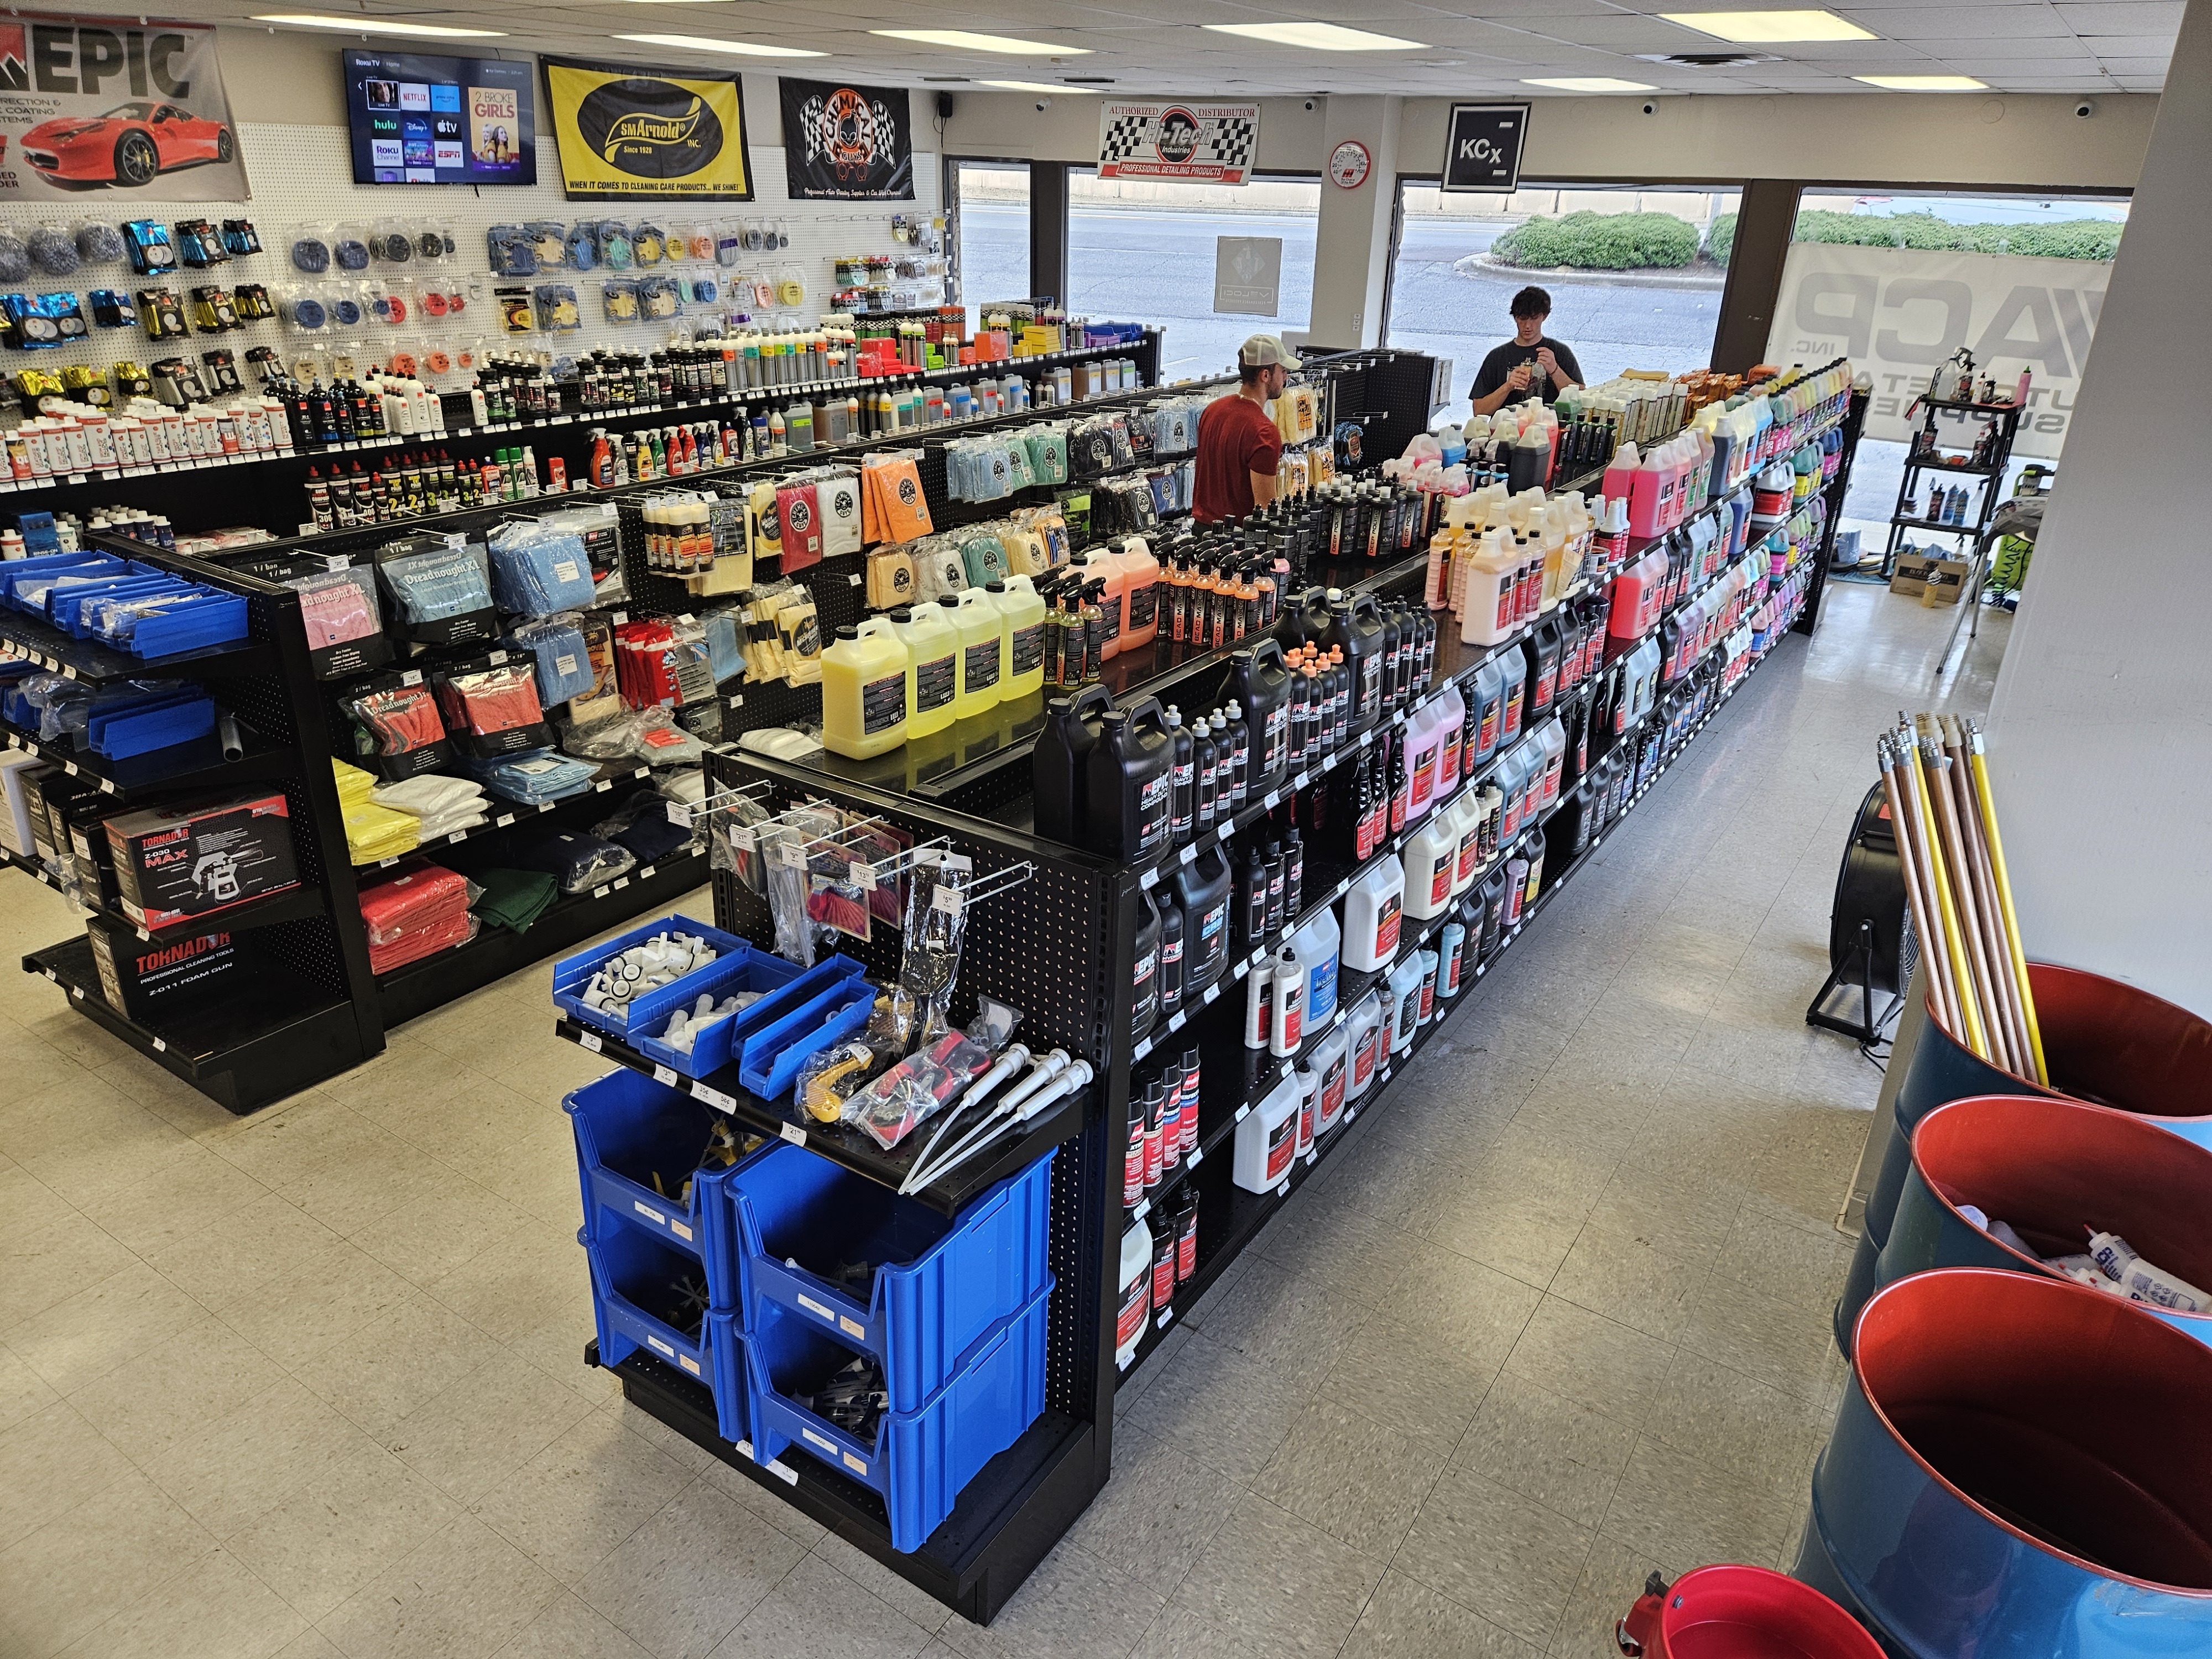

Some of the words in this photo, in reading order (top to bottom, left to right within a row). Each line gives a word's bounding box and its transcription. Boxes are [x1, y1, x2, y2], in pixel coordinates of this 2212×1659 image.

[32, 25, 190, 98] EPIC
[403, 93, 426, 102] NETFLIX
[476, 91, 482, 101] 2
[484, 92, 513, 103] BROKE
[475, 103, 515, 118] GIRLS
[1109, 106, 1159, 116] AUTHORIZED
[1199, 108, 1255, 117] DISTRIBUTOR
[374, 119, 397, 129] hulu
[826, 95, 871, 141] CHEMICAL
[377, 145, 399, 154] Roku
[624, 145, 638, 154] Since
[687, 139, 701, 148] INC.
[1162, 145, 1191, 154] Industries
[842, 152, 862, 162] GUYS
[1121, 164, 1160, 173] PROFESSIONAL
[1162, 166, 1190, 174] DETAILING
[1191, 167, 1221, 176] PRODUCTS
[570, 181, 587, 189] WHEN
[597, 181, 618, 190] COMES
[319, 514, 332, 523] 300
[404, 563, 468, 585] Dreadnought
[371, 694, 420, 714] Dreadnought
[1275, 703, 1288, 724] EPIC
[1152, 771, 1169, 795] EPIC
[1140, 792, 1168, 811] COMPOUND
[1141, 794, 1157, 805] HEAVY
[145, 849, 170, 859] Z-030
[145, 849, 189, 868] MAX
[1210, 902, 1224, 921] EPIC
[140, 966, 185, 984] PROFESSIONAL
[186, 954, 215, 968] CLEANING
[216, 947, 234, 957] TOOLS
[1138, 949, 1156, 975] EPIC
[149, 982, 178, 996] Z-011
[181, 971, 210, 984] FOAM
[211, 962, 233, 973] GUN
